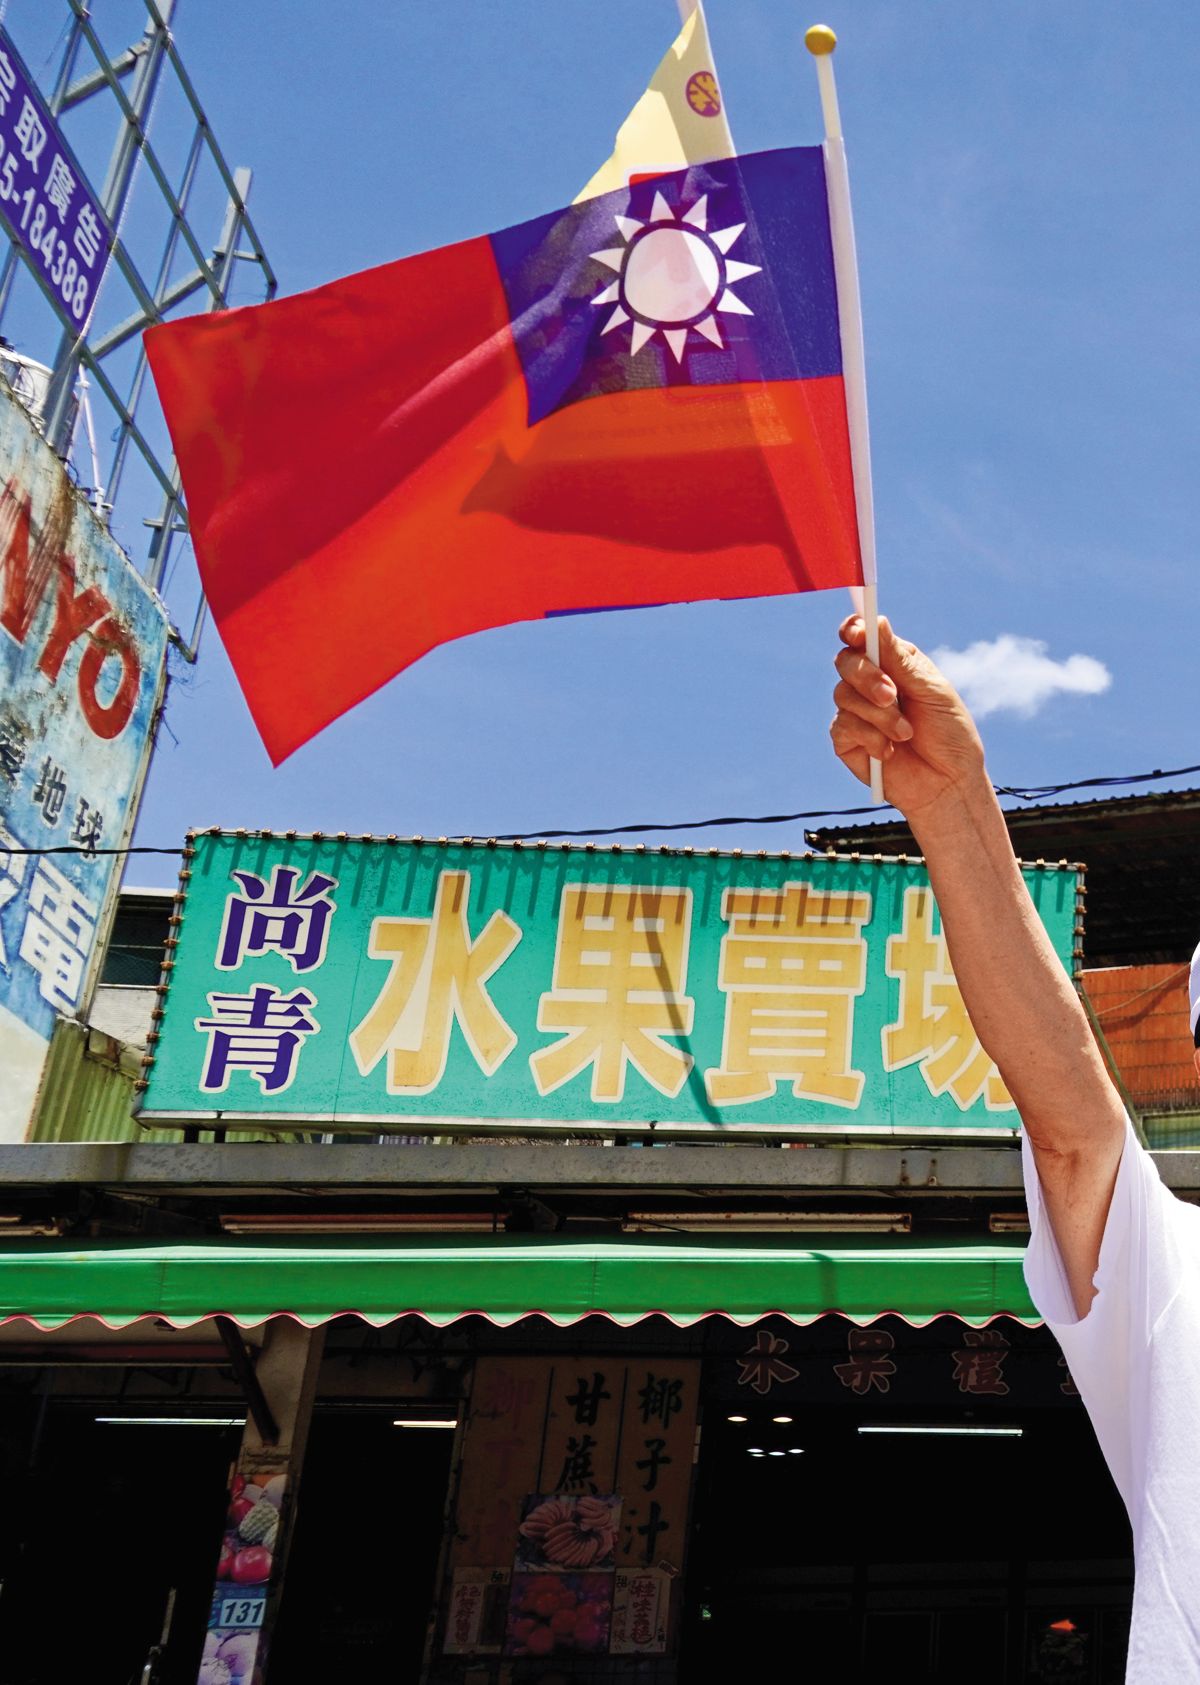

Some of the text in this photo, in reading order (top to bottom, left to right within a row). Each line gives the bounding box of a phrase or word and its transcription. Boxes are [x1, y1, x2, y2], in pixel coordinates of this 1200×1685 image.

[0, 134, 88, 319] 5-184388
[194, 866, 338, 1095] 尚青
[736, 1329, 1082, 1395] 水果禮
[623, 1371, 685, 1565] 椰子汁
[224, 1601, 264, 1624] 131
